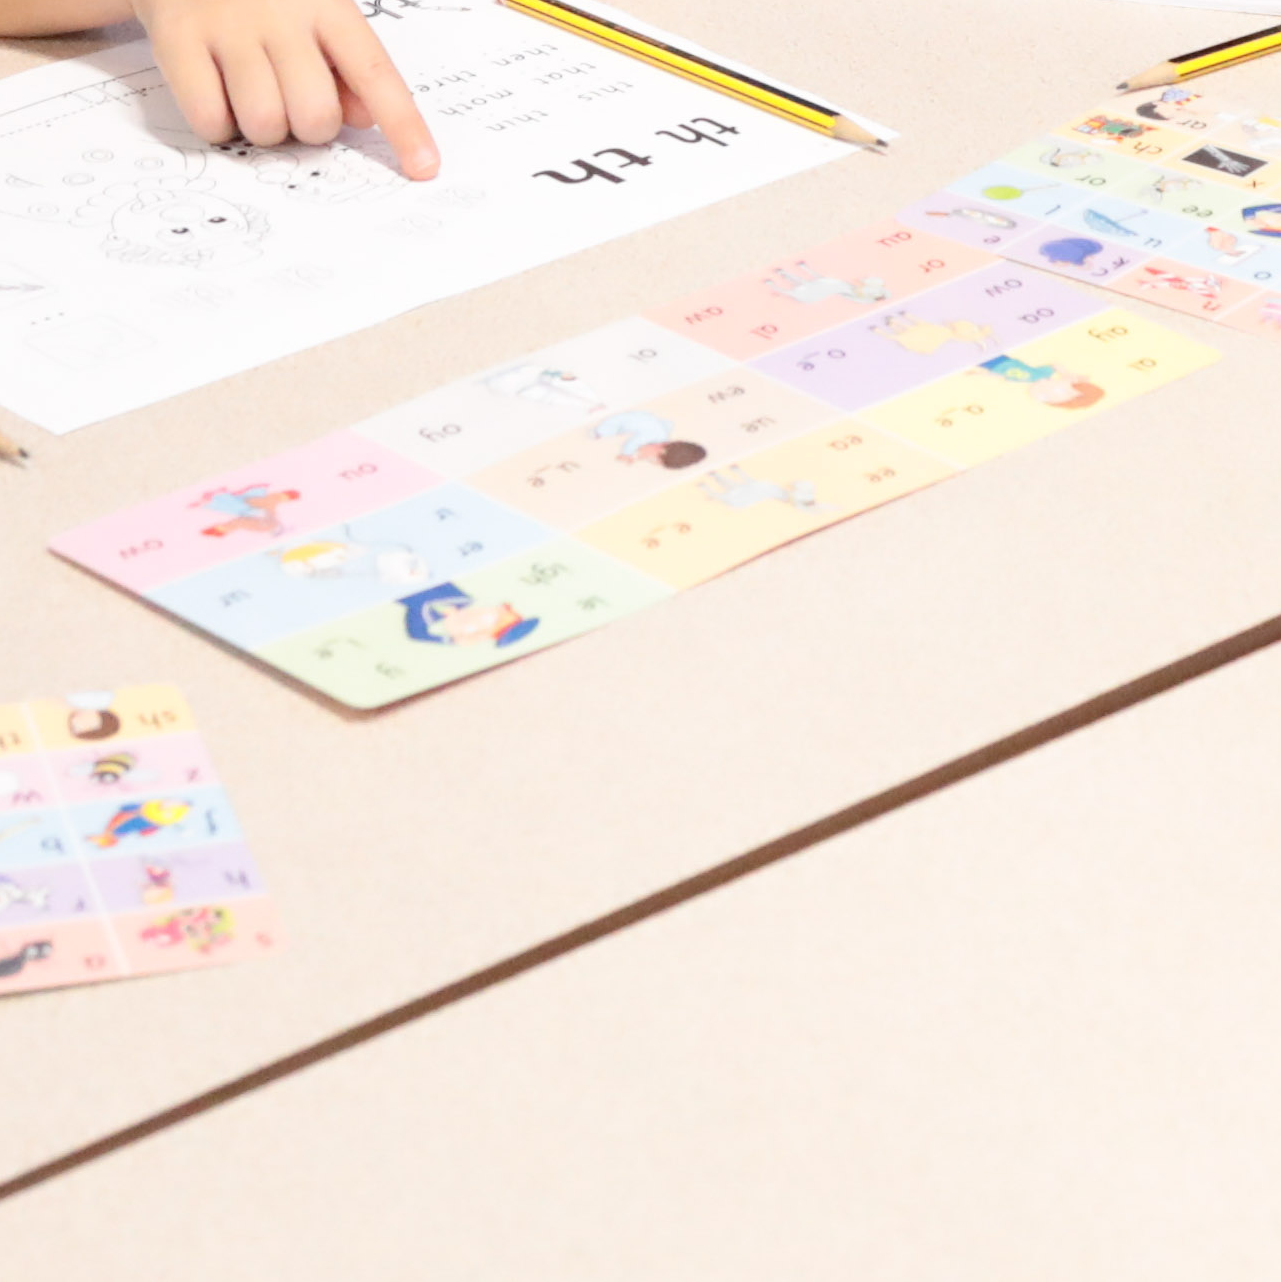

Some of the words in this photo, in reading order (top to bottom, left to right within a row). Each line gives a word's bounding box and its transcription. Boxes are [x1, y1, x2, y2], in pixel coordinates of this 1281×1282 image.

[408, 68, 478, 97] thre
[655, 116, 741, 149] th
[530, 148, 654, 186] th
